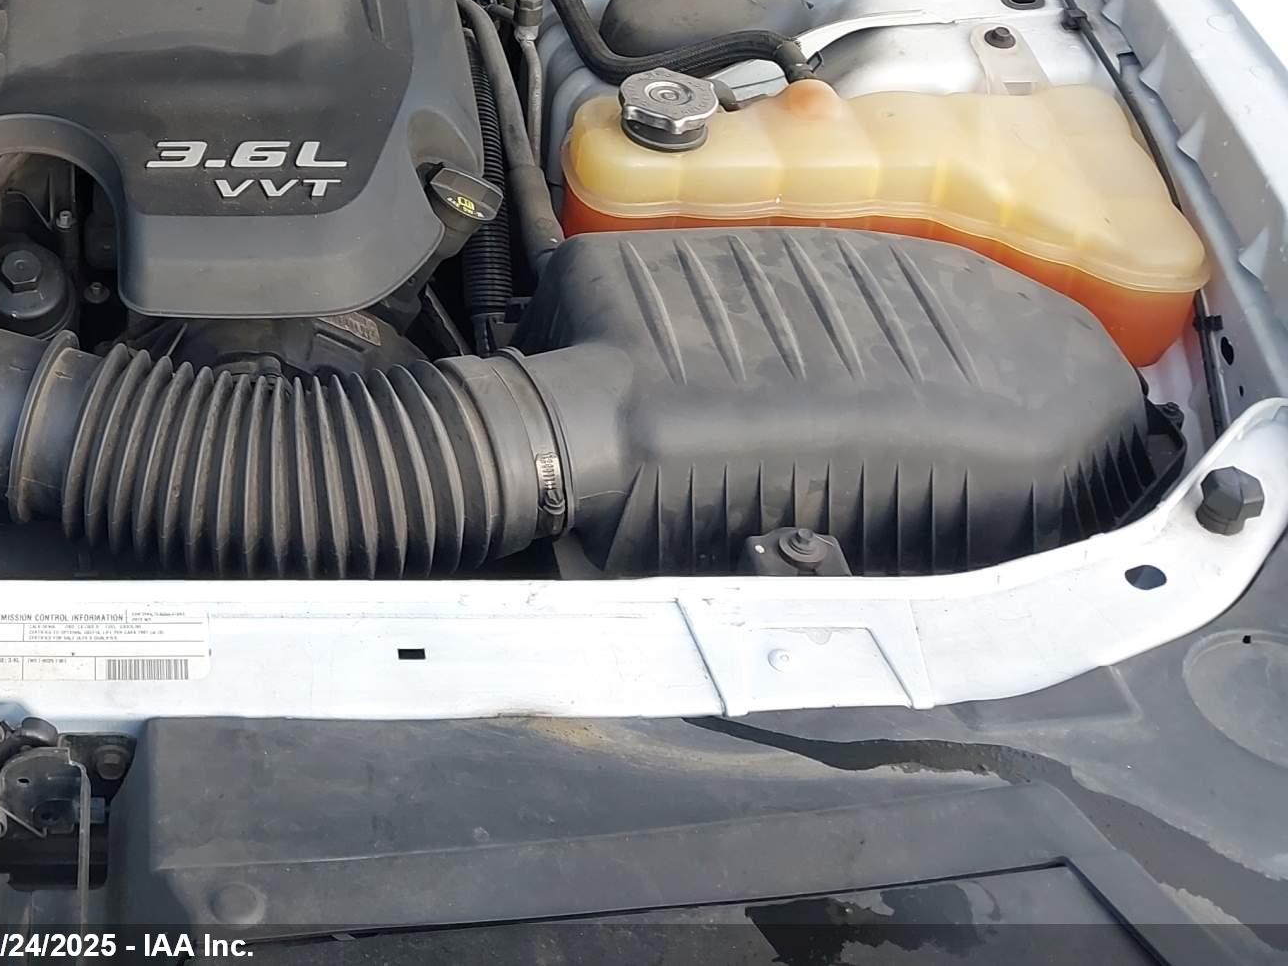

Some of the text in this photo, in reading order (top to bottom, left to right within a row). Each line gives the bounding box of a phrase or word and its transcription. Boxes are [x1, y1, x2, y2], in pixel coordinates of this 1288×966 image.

[145, 141, 348, 169] 3.6L
[214, 179, 342, 198] VVT
[35, 613, 69, 621] CONTROL
[71, 613, 124, 621] INFORMATION
